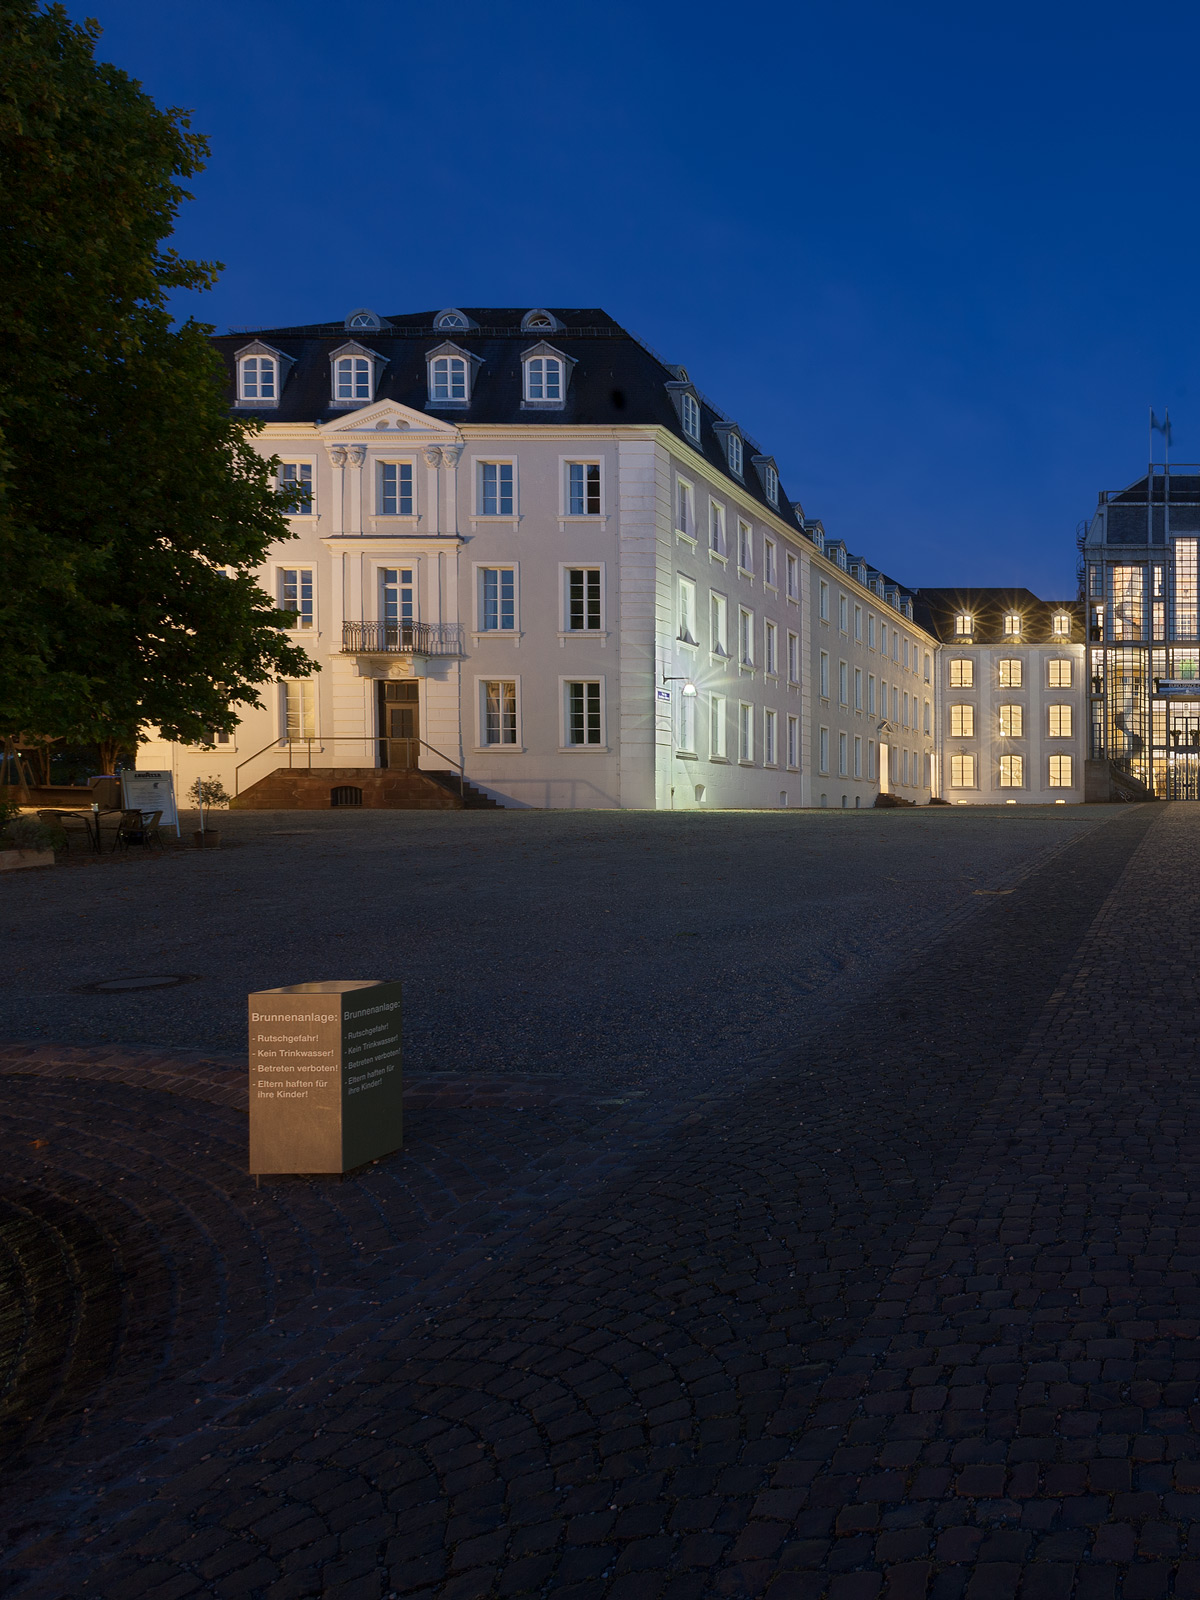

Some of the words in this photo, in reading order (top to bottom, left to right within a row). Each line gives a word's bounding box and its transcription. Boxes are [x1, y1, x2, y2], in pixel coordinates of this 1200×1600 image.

[251, 1013, 338, 1023] Brunnenanlage:
[344, 1001, 400, 1020] Brunnenanlage:
[258, 1035, 319, 1043] Rutschgefahr!
[348, 1023, 389, 1039] Rutschgefahr!
[348, 1046, 361, 1054] Kein
[363, 1034, 399, 1051] Trinkwasser!
[279, 1049, 334, 1057] Trinkwasser!
[348, 1056, 373, 1069] Betreten
[375, 1048, 401, 1061] verboten!
[258, 1080, 283, 1088] Eltern
[348, 1074, 366, 1085] Eltern
[367, 1067, 385, 1079] haften
[348, 1086, 360, 1095] ihre
[361, 1078, 382, 1091] Kinder!
